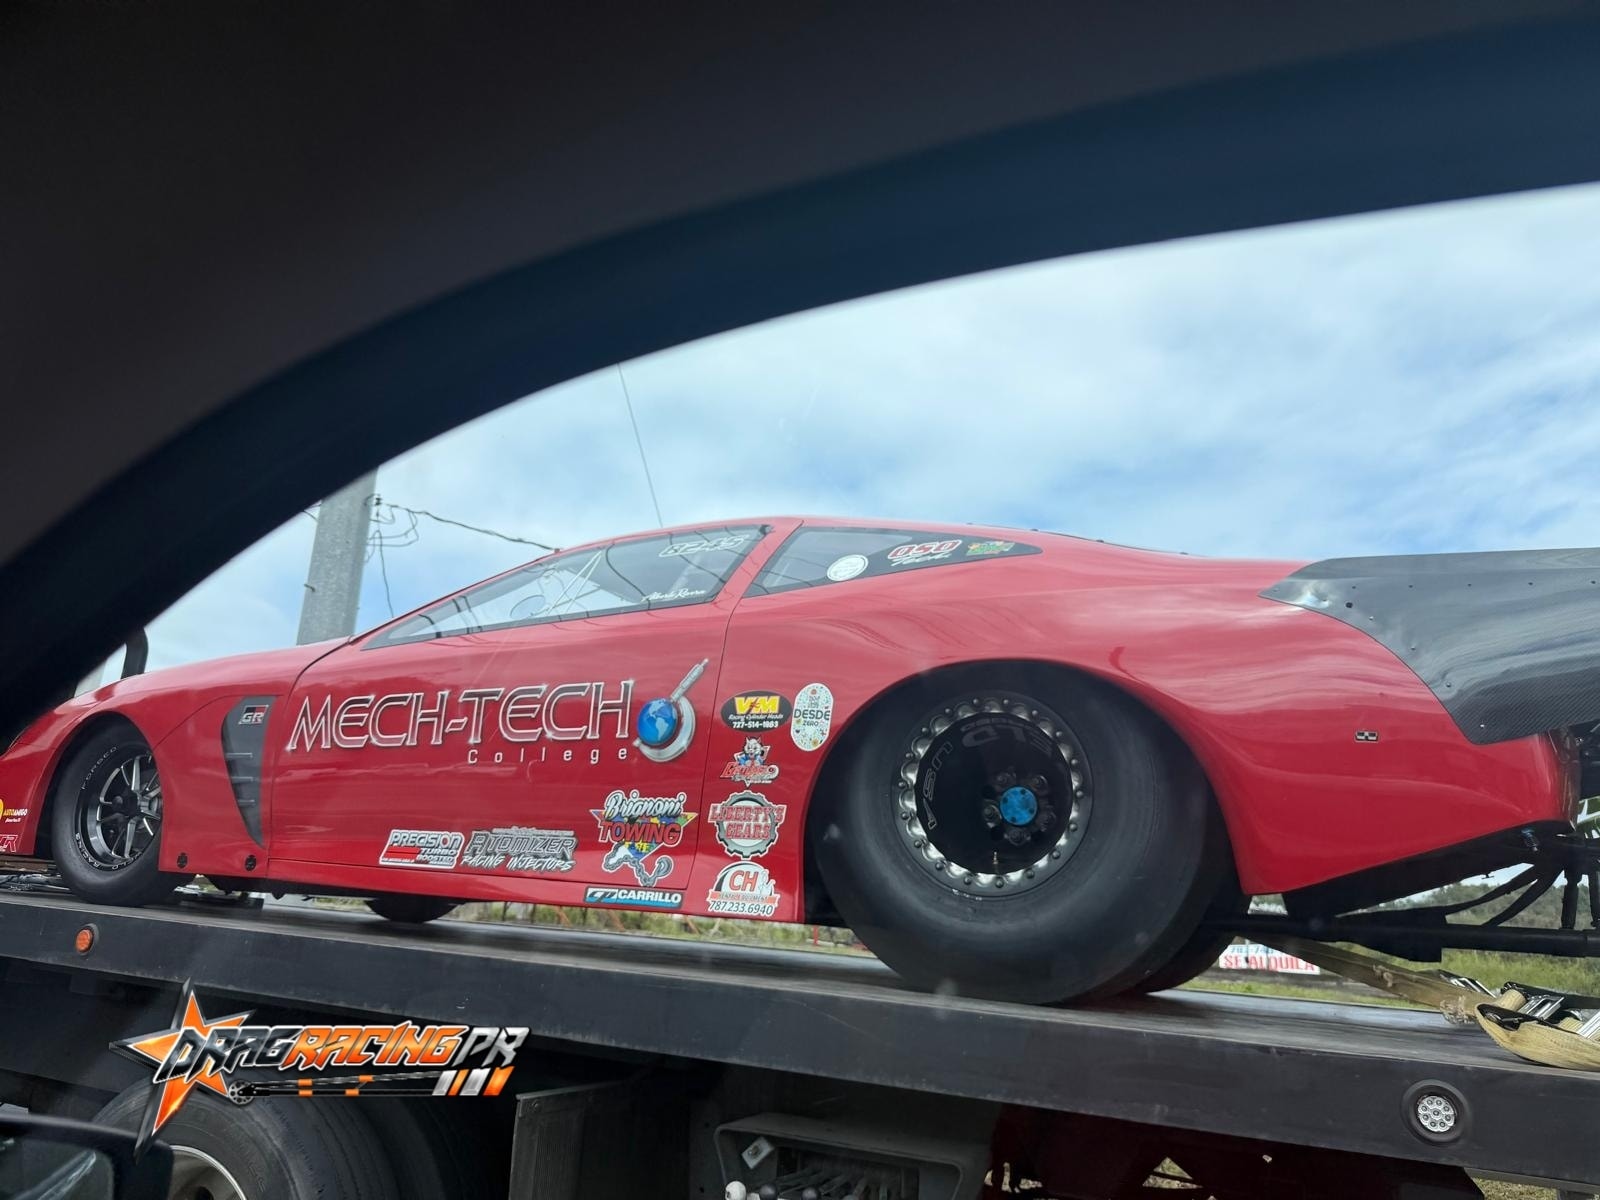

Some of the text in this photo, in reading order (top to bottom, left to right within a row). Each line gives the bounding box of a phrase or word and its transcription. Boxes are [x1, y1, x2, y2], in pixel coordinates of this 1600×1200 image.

[241, 712, 264, 723] GR
[286, 680, 634, 751] MECH-TECH
[794, 708, 831, 721] DESDE
[803, 719, 819, 727] ZERO
[468, 748, 627, 764] College
[605, 793, 684, 820] Brignoni
[711, 806, 785, 822] LIBERTY'S
[601, 822, 680, 845] TOWING
[725, 823, 771, 839] GEARS
[391, 832, 462, 848] PRECISION
[464, 831, 577, 860] ATOMIZER
[416, 854, 454, 863] BOOSTED
[420, 848, 457, 856] TURBO
[461, 854, 576, 871] RACING INJECTORS
[729, 870, 759, 892] CH
[618, 889, 682, 903] CARRILLO
[710, 900, 773, 915] 787.233.6940
